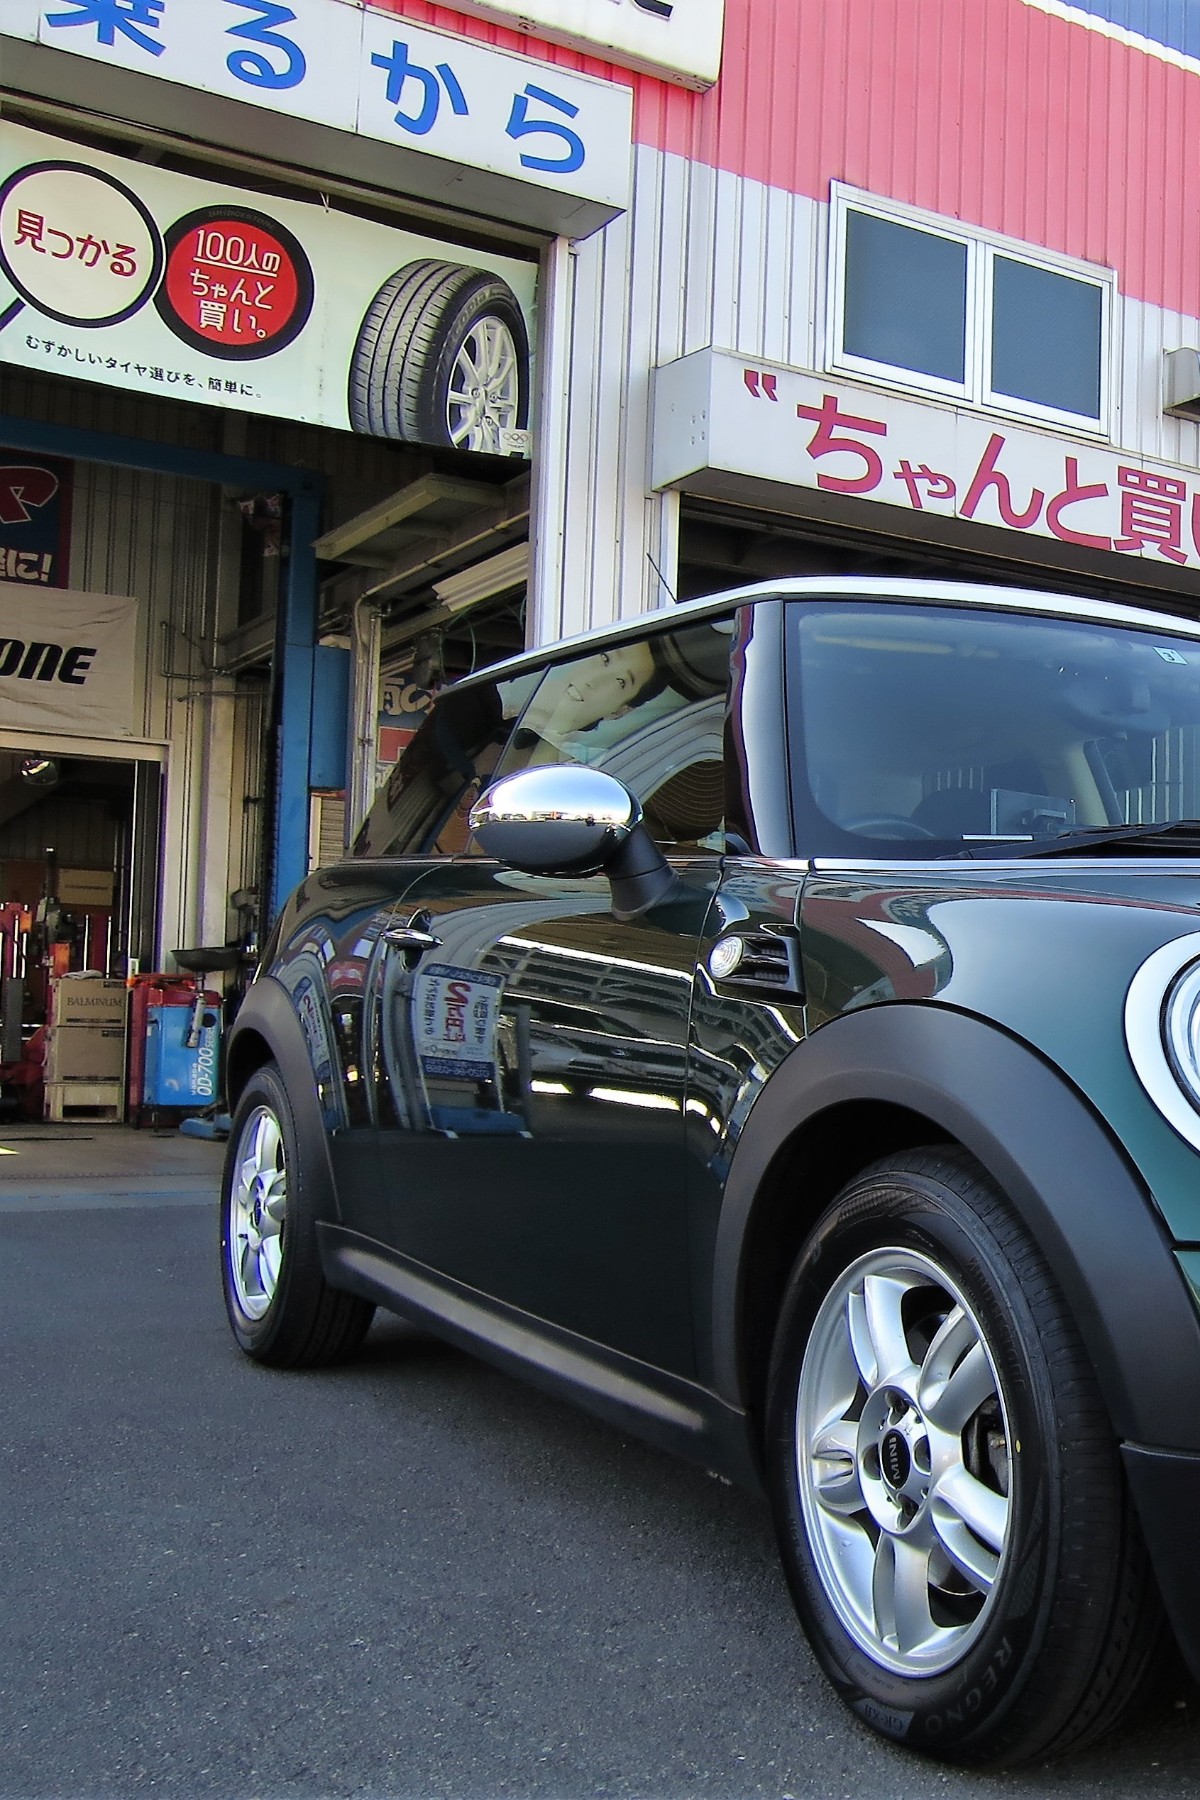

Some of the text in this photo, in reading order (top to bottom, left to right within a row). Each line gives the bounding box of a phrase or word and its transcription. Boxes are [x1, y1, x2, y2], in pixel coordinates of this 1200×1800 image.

[14, 208, 137, 277] 見つかる
[195, 229, 281, 272] 100人の
[190, 268, 275, 310] ちゃんと
[199, 301, 268, 339] 買い。
[67, 997, 124, 1007] BALMINUM
[889, 1436, 901, 1480] MINI
[925, 1636, 1013, 1735] REGNO
